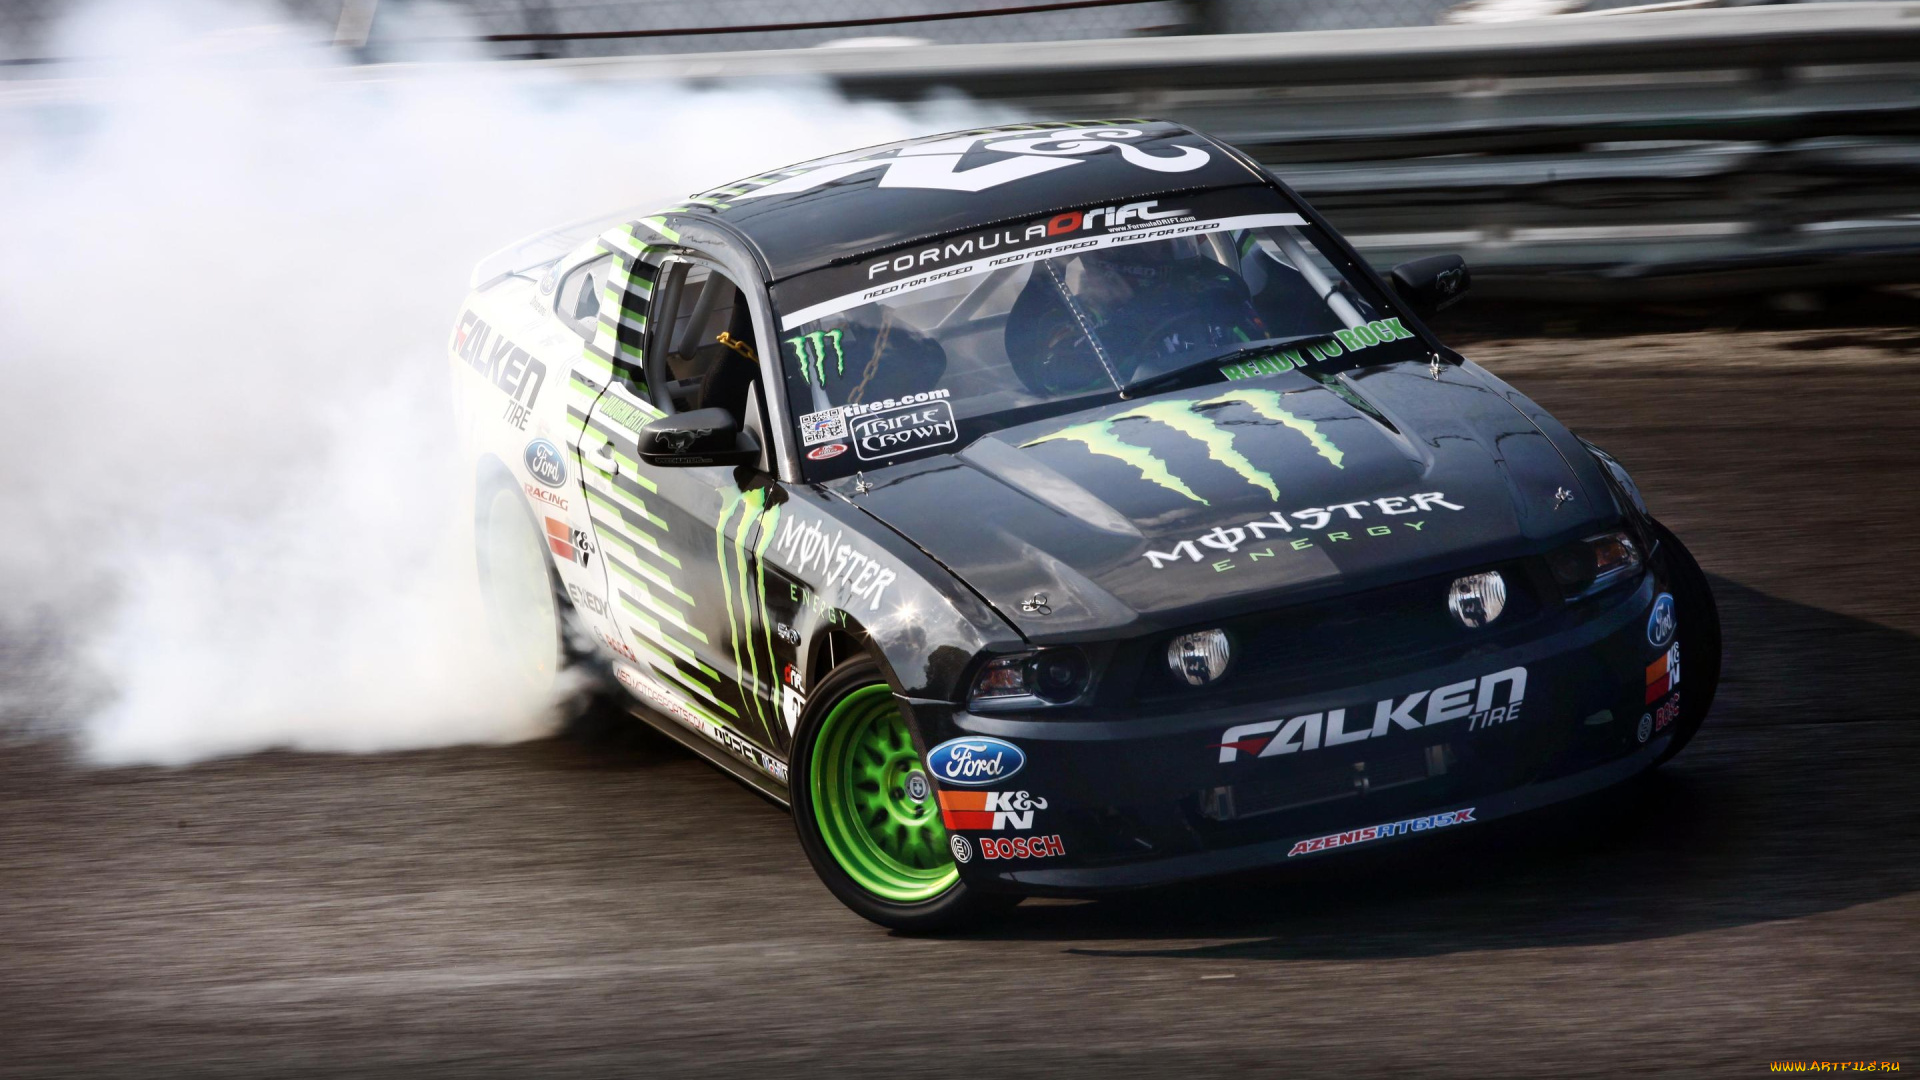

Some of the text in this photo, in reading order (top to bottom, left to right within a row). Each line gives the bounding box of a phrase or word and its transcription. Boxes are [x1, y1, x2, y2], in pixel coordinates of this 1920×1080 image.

[1111, 222, 1220, 243] NEED FOR SPEED
[868, 224, 1047, 280] FORMULA
[989, 239, 1098, 267] NEED FOR SPEED
[864, 265, 973, 301] NEED FOR SPEED
[1333, 316, 1415, 352] ROCK
[452, 308, 547, 411] FALKEN
[503, 399, 532, 431] TIRE
[843, 388, 951, 418] tires.com
[856, 409, 939, 437] TRIPLE
[861, 420, 951, 451] CROWN
[532, 443, 560, 482] Ford
[523, 482, 569, 511] RACING
[1212, 521, 1426, 573] ENERGY
[568, 583, 608, 619] EXEDY
[790, 584, 847, 628] ENERGY
[1655, 602, 1673, 642] Ford
[1206, 666, 1528, 763] FALKEN
[1468, 701, 1522, 732] TIRE
[946, 744, 1004, 777] Ford
[980, 835, 1065, 859] BOSCH
